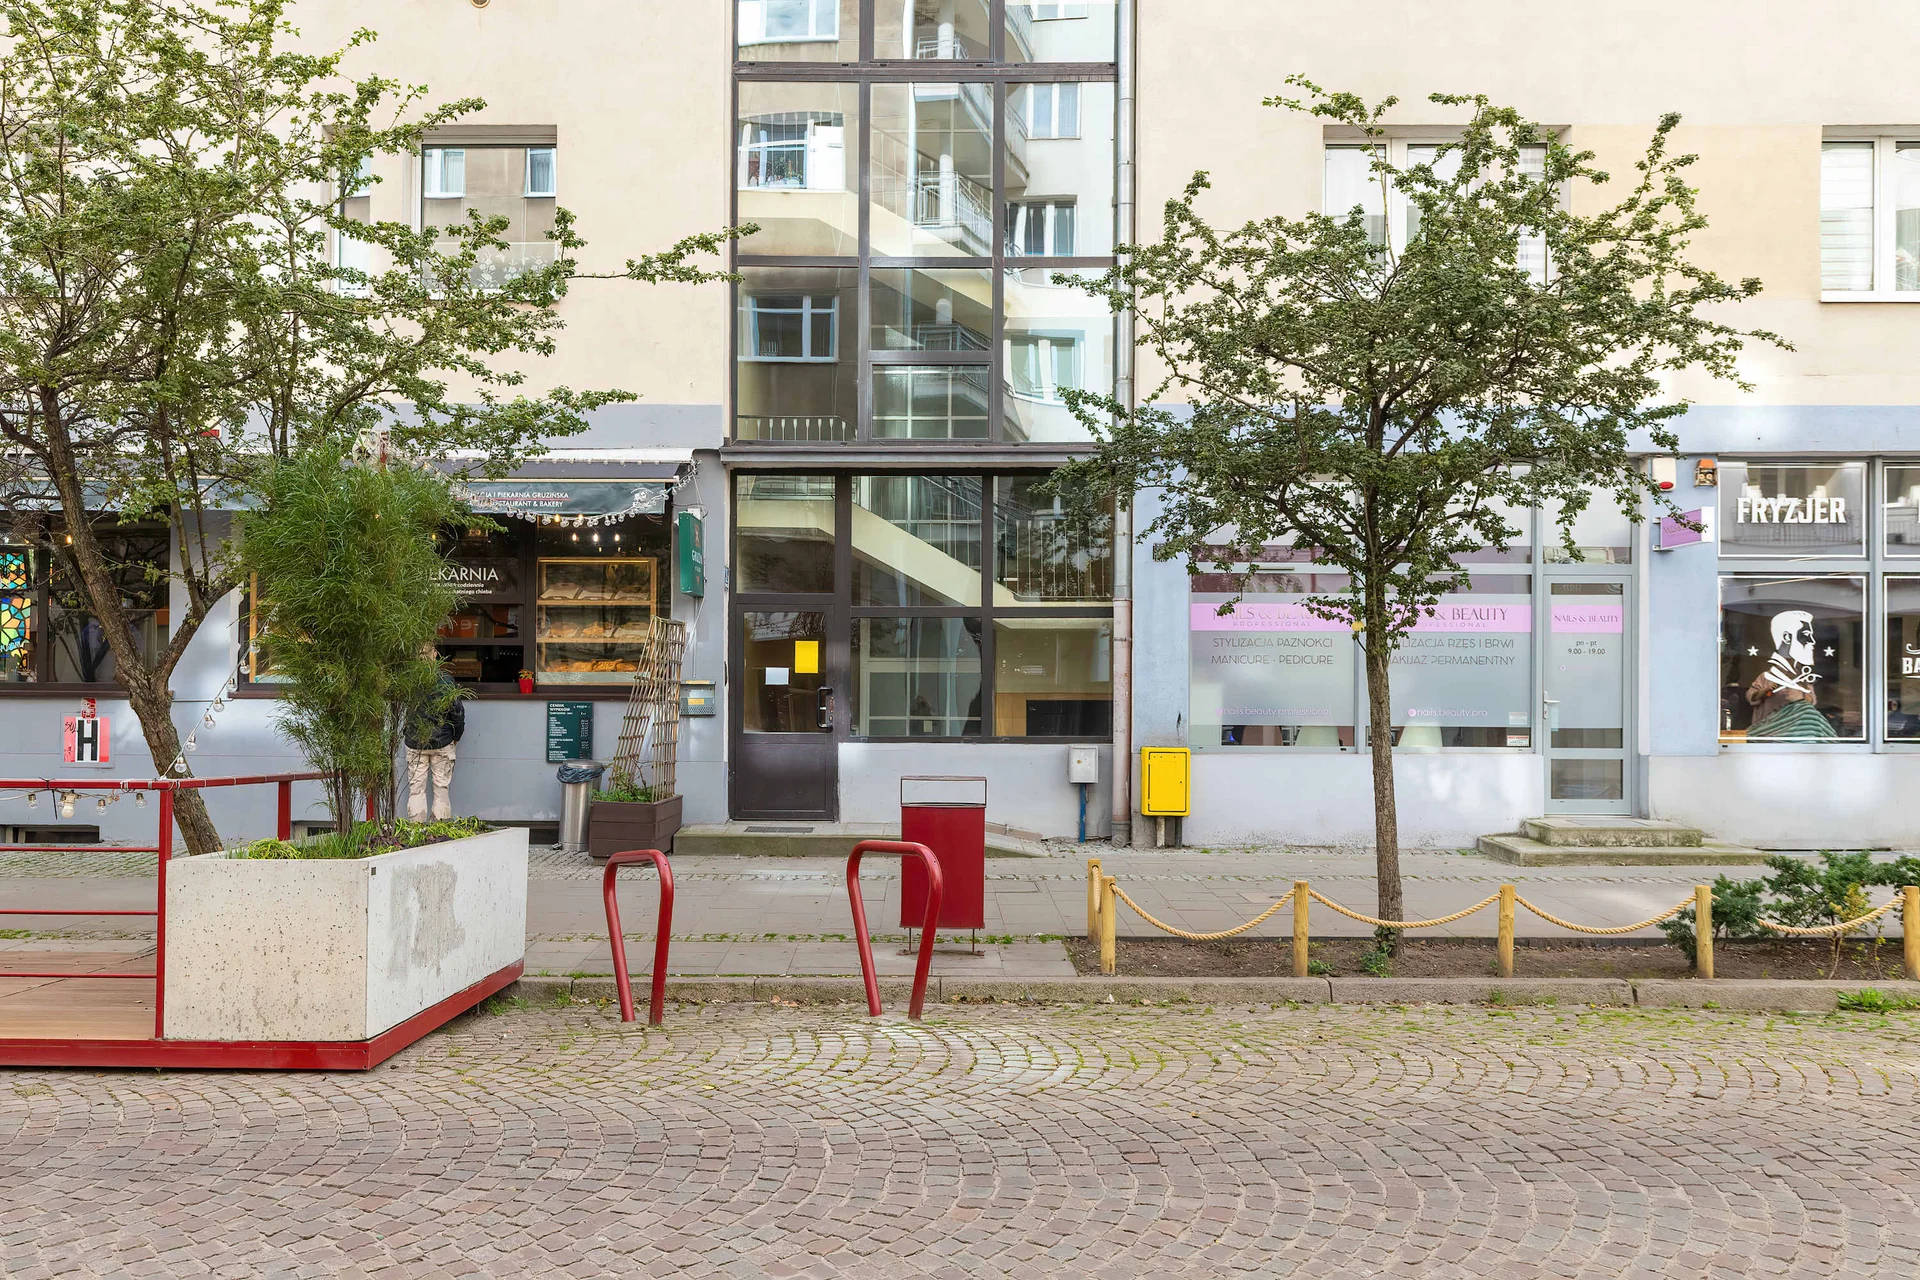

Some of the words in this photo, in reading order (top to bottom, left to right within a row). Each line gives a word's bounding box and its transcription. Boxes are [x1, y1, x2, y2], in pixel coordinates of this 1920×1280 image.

[532, 490, 569, 498] GRUZIŃSKA
[1737, 497, 1847, 523] FRYZJER
[1452, 608, 1508, 620] BEAUTY
[1554, 615, 1577, 623] NAILS
[1578, 615, 1586, 623] &
[1588, 615, 1619, 623] BEAUTY
[1213, 637, 1274, 648] STYLIZACJA
[1277, 637, 1333, 648] PAZNOKCI
[1447, 638, 1477, 650] RZĘS
[1484, 638, 1514, 649] BRWI
[1211, 655, 1270, 665] MANICURE
[1279, 655, 1334, 665] PEDICURE
[1390, 653, 1428, 665] AKIJAŻ
[77, 720, 98, 761] H
